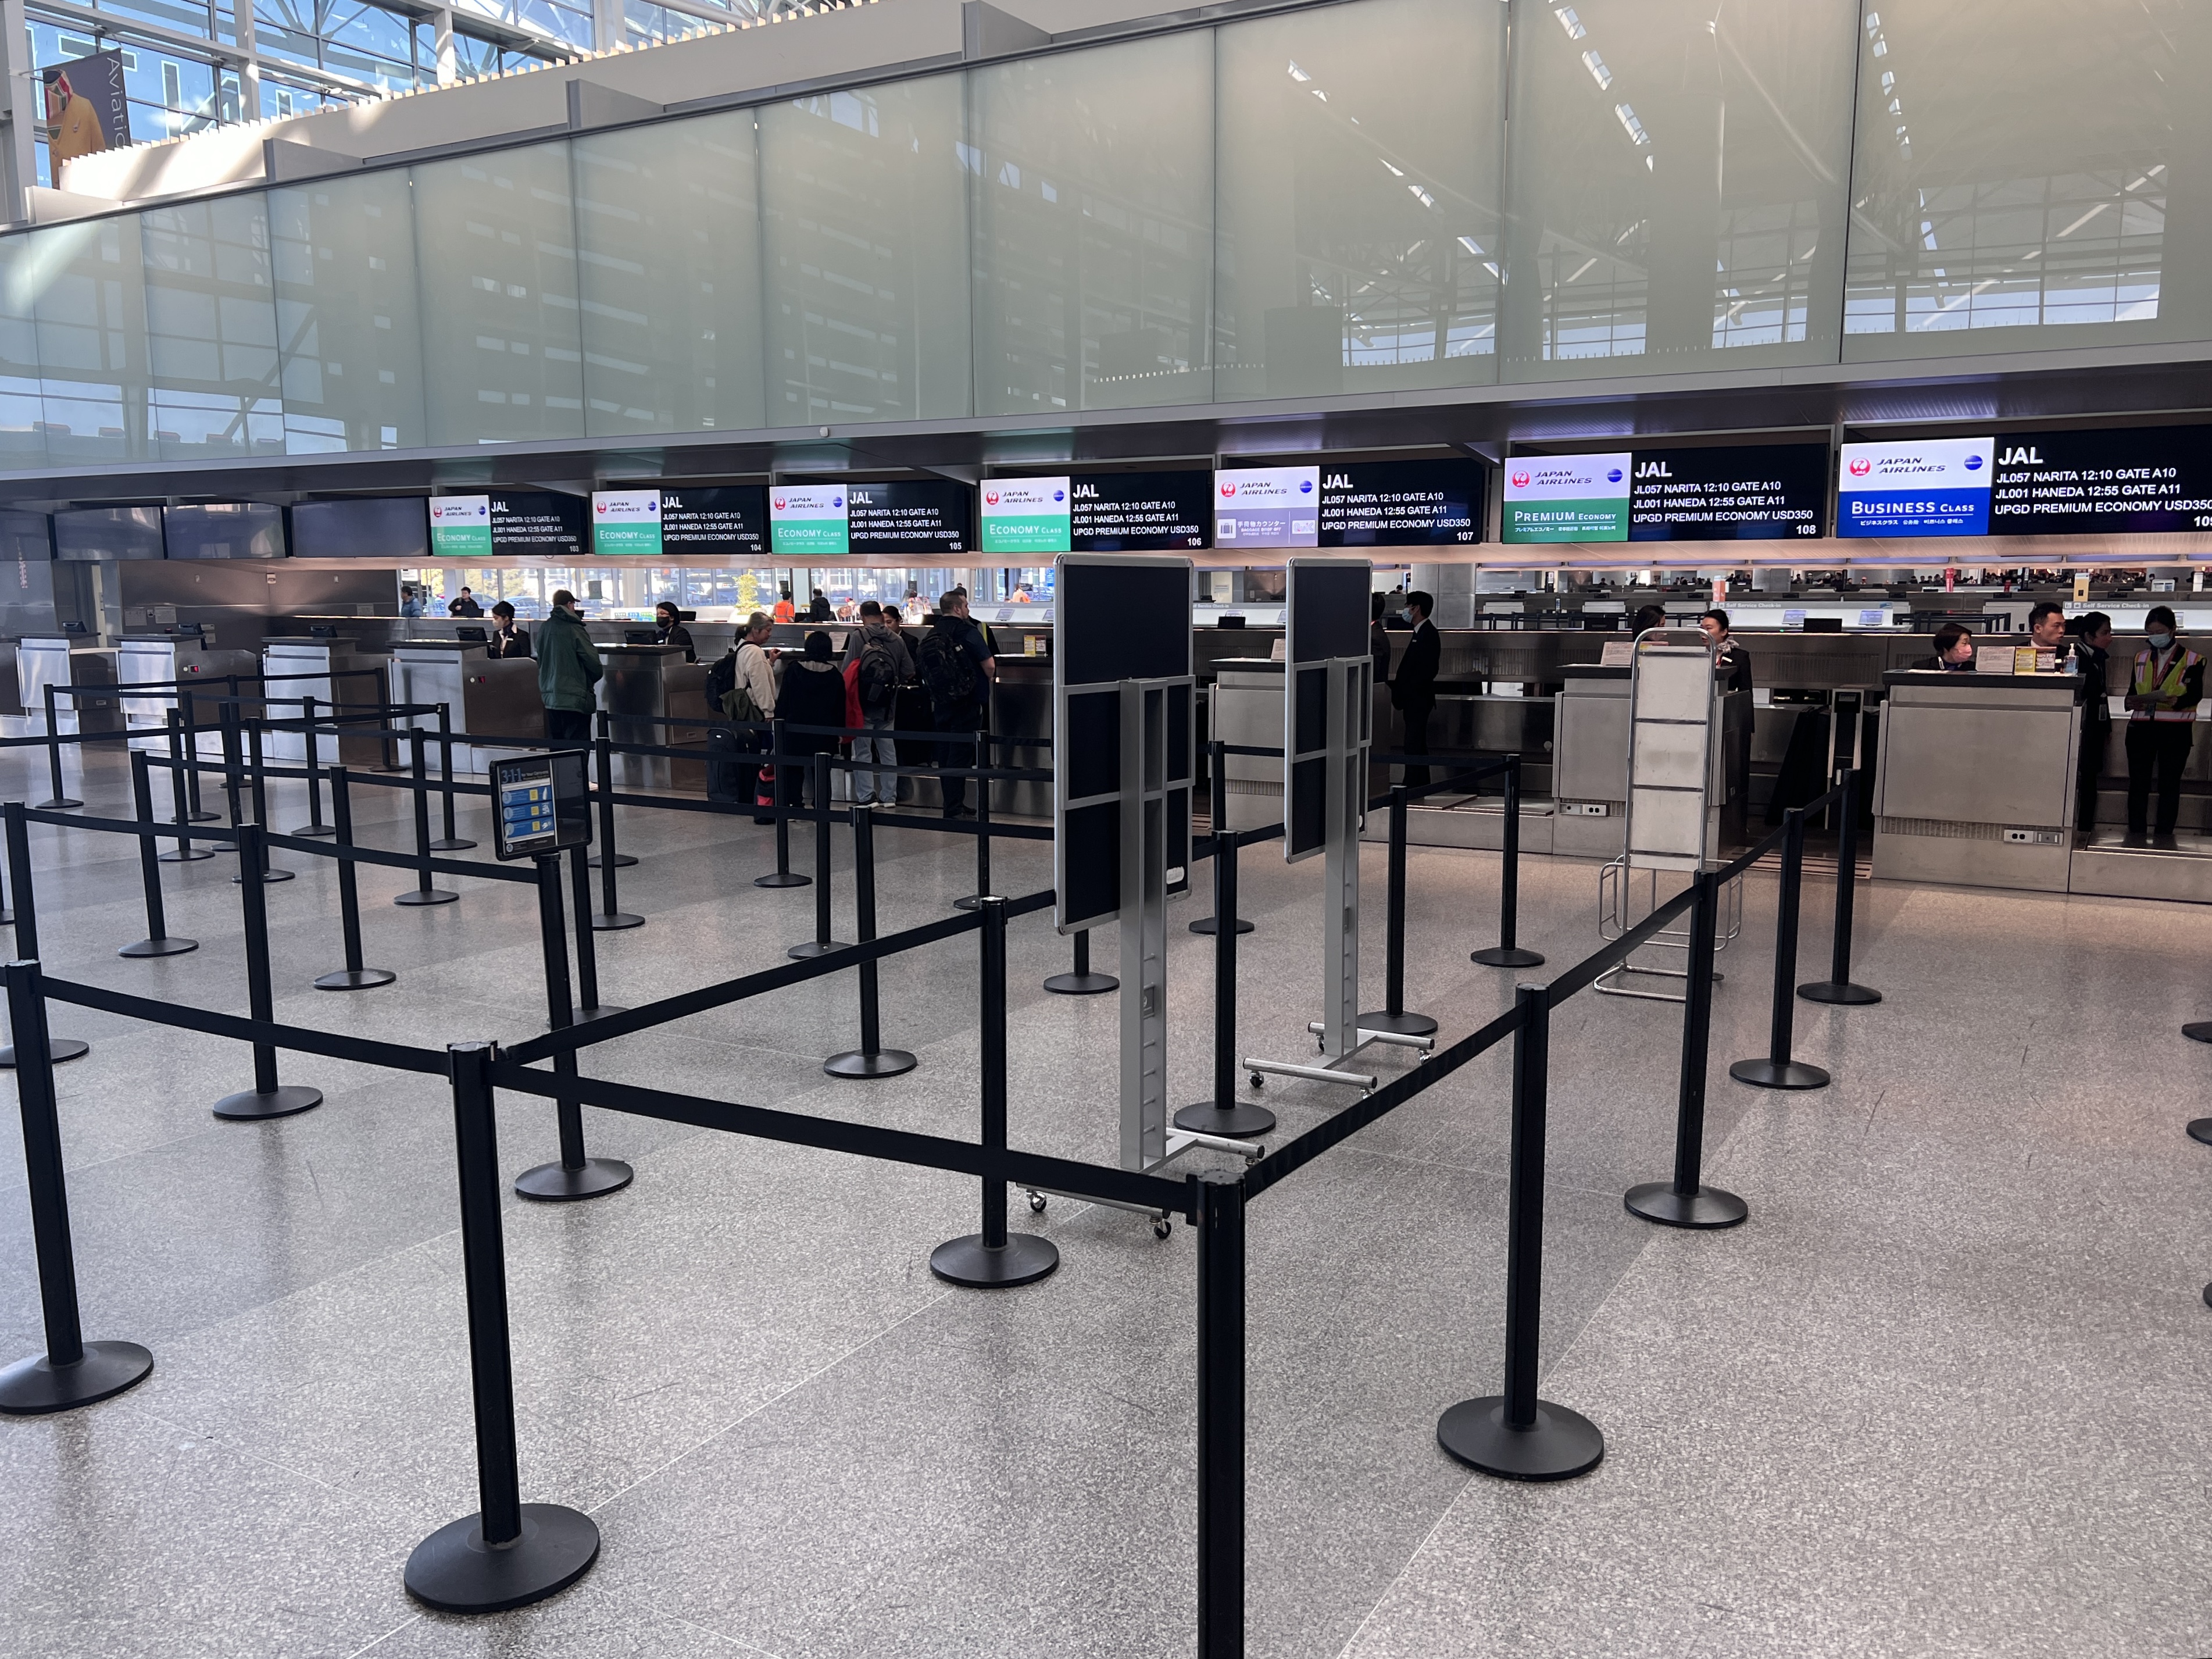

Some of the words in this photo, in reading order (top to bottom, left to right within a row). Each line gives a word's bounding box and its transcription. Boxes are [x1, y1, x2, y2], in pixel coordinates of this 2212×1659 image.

[1999, 447, 2043, 465] JAL
[1635, 462, 1672, 477] JAL
[1997, 473, 2030, 483] JL057
[2034, 471, 2078, 481] NARITA
[2082, 470, 2113, 480] 12:10
[2116, 469, 2150, 479] GATE
[2152, 468, 2176, 478] A10
[1323, 474, 1353, 489] JAL
[1073, 484, 1099, 498] JAL
[1634, 485, 1662, 494] JL057
[1664, 484, 1701, 493] NARITA
[1704, 483, 1729, 492] 12:10
[1732, 482, 1759, 491] GATE
[1761, 481, 1781, 490] A10
[1996, 488, 2028, 498] JL001
[2032, 487, 2084, 497] HANEDA
[2088, 486, 2118, 496] 12:55
[2122, 484, 2156, 495] GATE
[2159, 484, 2179, 494] A11
[663, 497, 682, 508] JAL
[850, 492, 872, 504] JAL
[1322, 495, 1345, 504] JL057
[1347, 494, 1377, 503] NARITA
[1380, 494, 1400, 502] 12:10
[1403, 493, 1425, 501] GATE
[1634, 500, 1660, 508] JL001
[1664, 498, 1706, 508] HANEDA
[1709, 497, 1734, 506] 12:55
[1737, 497, 1765, 505] GATE
[1767, 496, 1784, 505] A11
[491, 502, 509, 512] JAL
[1141, 501, 1160, 509] GATE
[1995, 505, 2030, 514] UPGD
[2034, 503, 2092, 513] PREMIUM
[2095, 501, 2162, 512] ECONOMY
[2165, 500, 2212, 511] USD350
[1322, 509, 1344, 517] JL001
[1347, 508, 1382, 516] HANEDA
[1384, 506, 1405, 515] 12:55
[1407, 506, 1430, 514] GATE
[1634, 513, 1662, 522] UPGD
[1665, 512, 1713, 522] PREMIUM
[1716, 511, 1770, 520] ECONOMY
[1773, 511, 1813, 519] USD350
[1131, 526, 1168, 534] ECONOMY
[1171, 525, 1198, 533] USD350
[1322, 522, 1346, 530] UPGD
[1348, 520, 1388, 529] PREMIUM
[1390, 519, 1435, 528] ECONOMY
[1437, 519, 1470, 527] USD350
[1796, 525, 1816, 534] 108
[1457, 532, 1473, 540] 107
